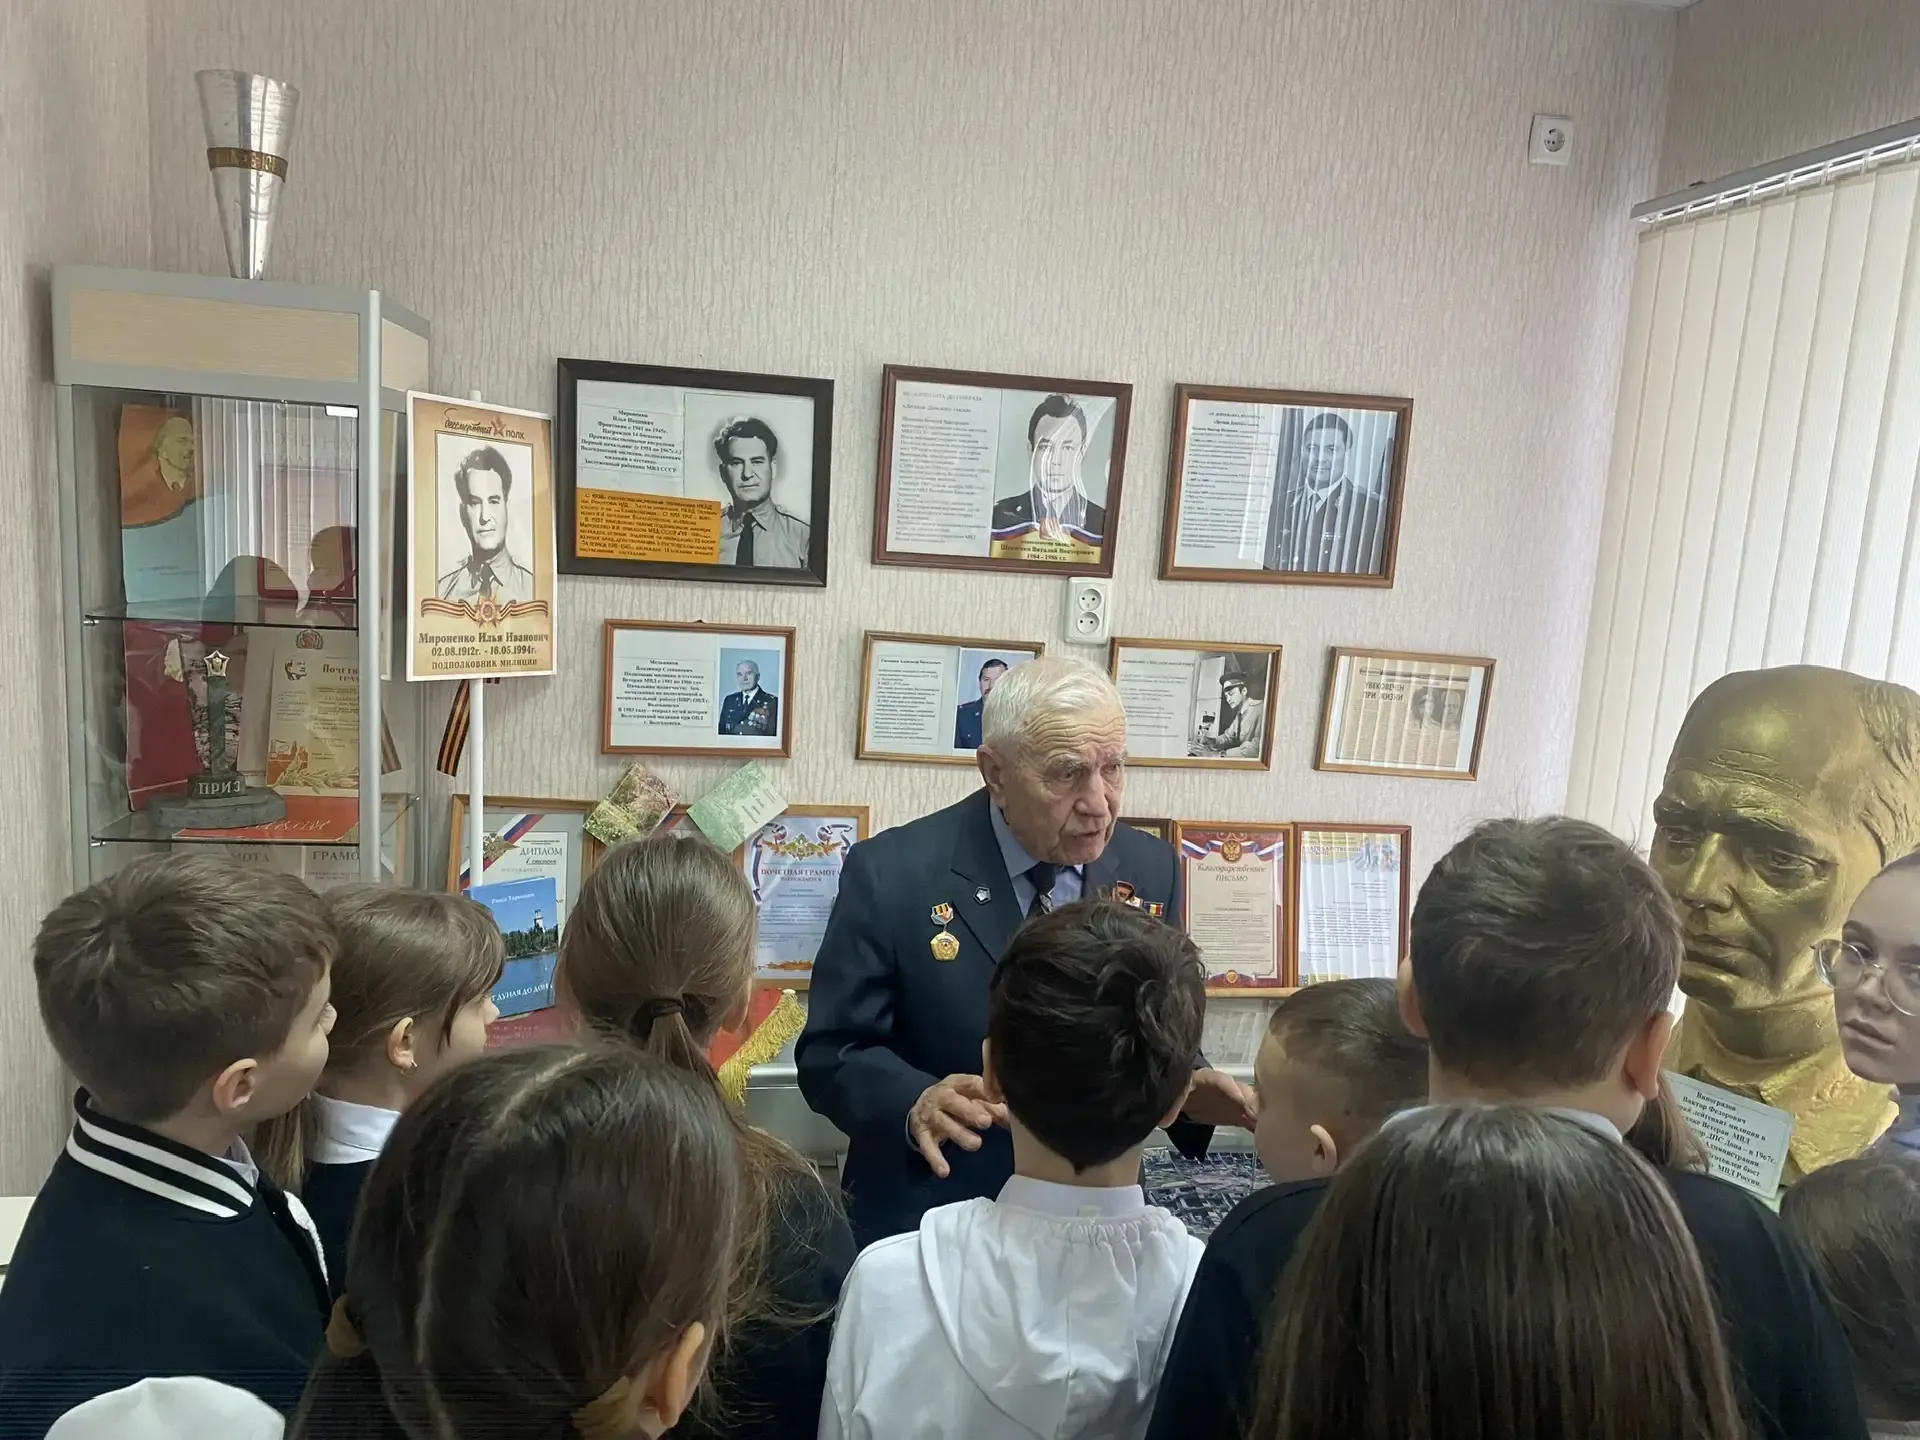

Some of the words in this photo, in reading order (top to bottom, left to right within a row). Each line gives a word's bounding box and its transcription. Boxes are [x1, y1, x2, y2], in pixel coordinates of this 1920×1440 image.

[418, 631, 476, 647] Мироненко
[478, 631, 503, 643] Илья
[505, 630, 550, 643] Иванович
[431, 646, 481, 657] 02.08.1912г.
[490, 645, 537, 656] 16.05.1994г.
[432, 659, 498, 671] подполковник
[500, 658, 538, 667] милиции
[198, 780, 241, 796] ПРИЗ
[519, 847, 563, 857] ДИПЛОМ
[1696, 1091, 1737, 1111] Виноградов
[1682, 1096, 1707, 1111] Виктор
[1707, 1103, 1747, 1124] Федорович
[1702, 1121, 1730, 1136] Ветеран
[1731, 1131, 1751, 1145] МВД
[1706, 1133, 1724, 1142] ДПС
[1755, 1150, 1777, 1165] 1967г.
[1717, 1164, 1737, 1177] МВД
